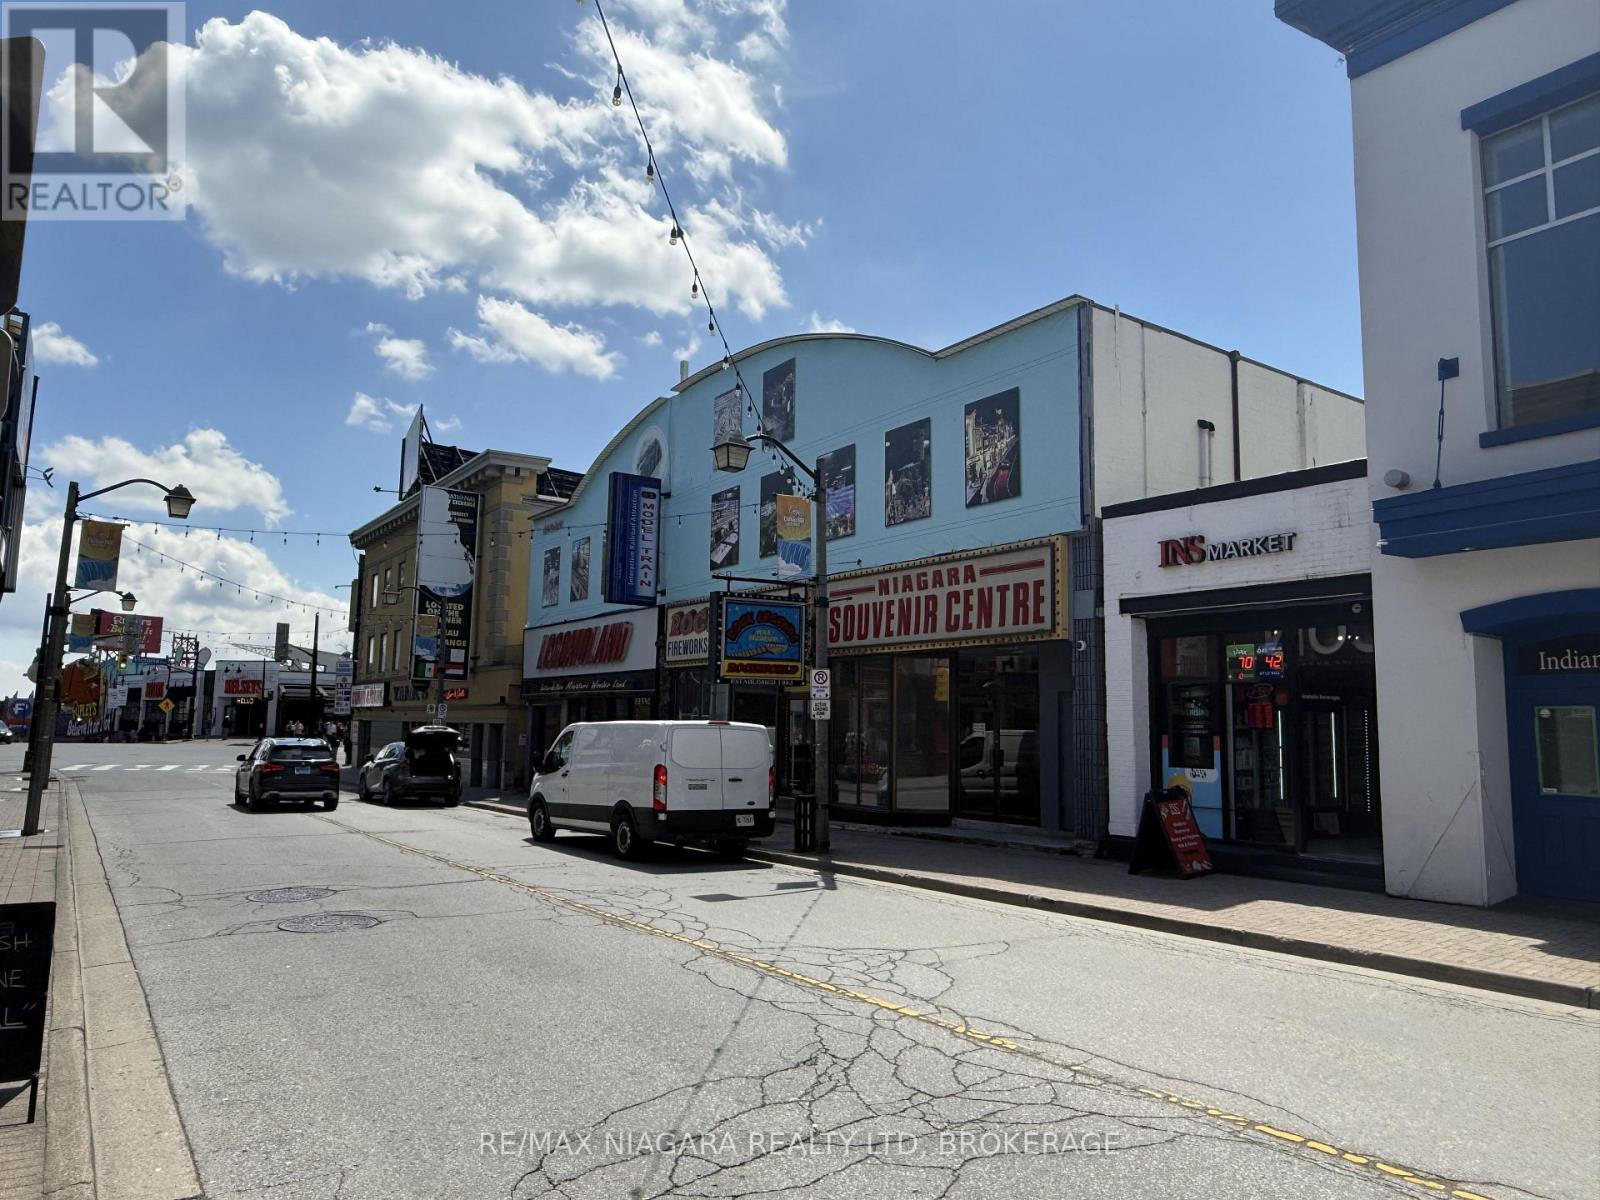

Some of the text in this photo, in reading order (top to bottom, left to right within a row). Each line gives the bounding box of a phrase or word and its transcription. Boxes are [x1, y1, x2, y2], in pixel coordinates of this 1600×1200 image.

[1158, 532, 1297, 568] INS MARKET
[640, 547, 653, 587] TRAIN
[878, 564, 977, 596] NIAGARA
[426, 601, 464, 610] LOTED
[829, 579, 1045, 643] SOUVENIR CENTRE
[667, 637, 708, 657] FIREWORKS
[1238, 655, 1282, 669] 70 42
[236, 697, 254, 705] HELLO
[66, 720, 87, 736] Believe
